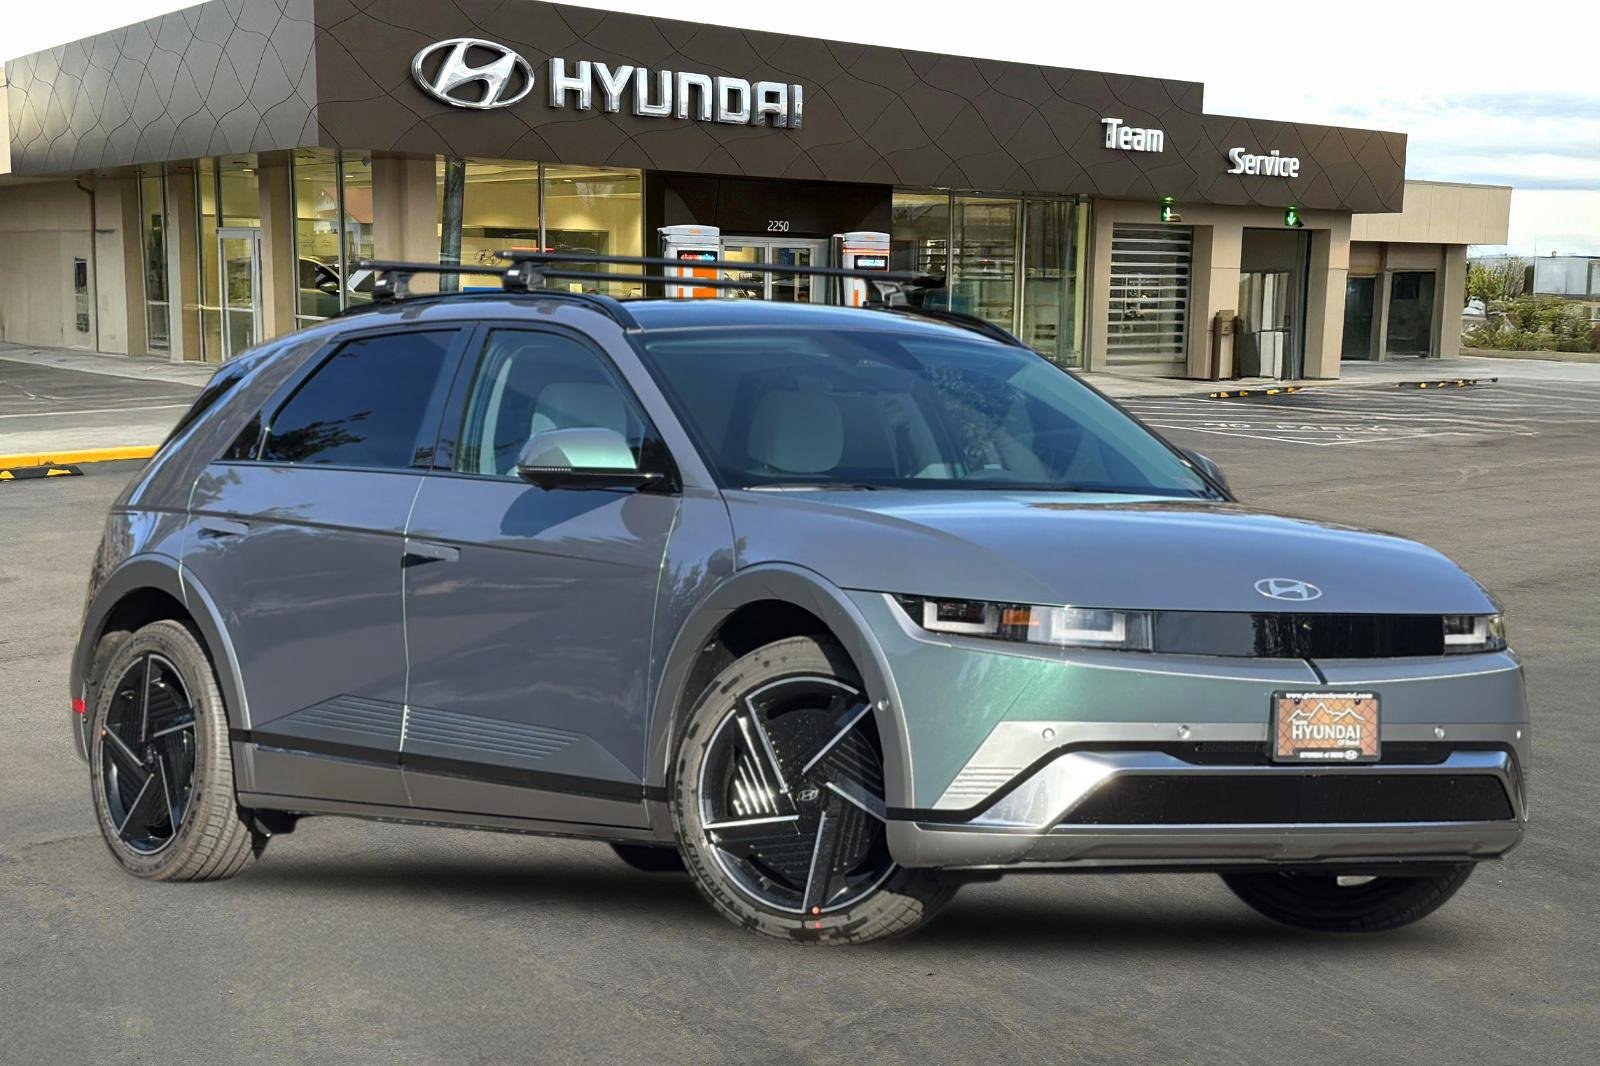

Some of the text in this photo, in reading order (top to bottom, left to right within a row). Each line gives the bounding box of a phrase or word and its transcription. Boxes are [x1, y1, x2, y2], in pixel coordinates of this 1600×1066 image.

[549, 57, 802, 129] HYUNDAI
[1101, 117, 1164, 153] Team
[1227, 147, 1300, 178] Service
[767, 220, 790, 232] 2250
[1292, 725, 1361, 740] HYUNDAI
